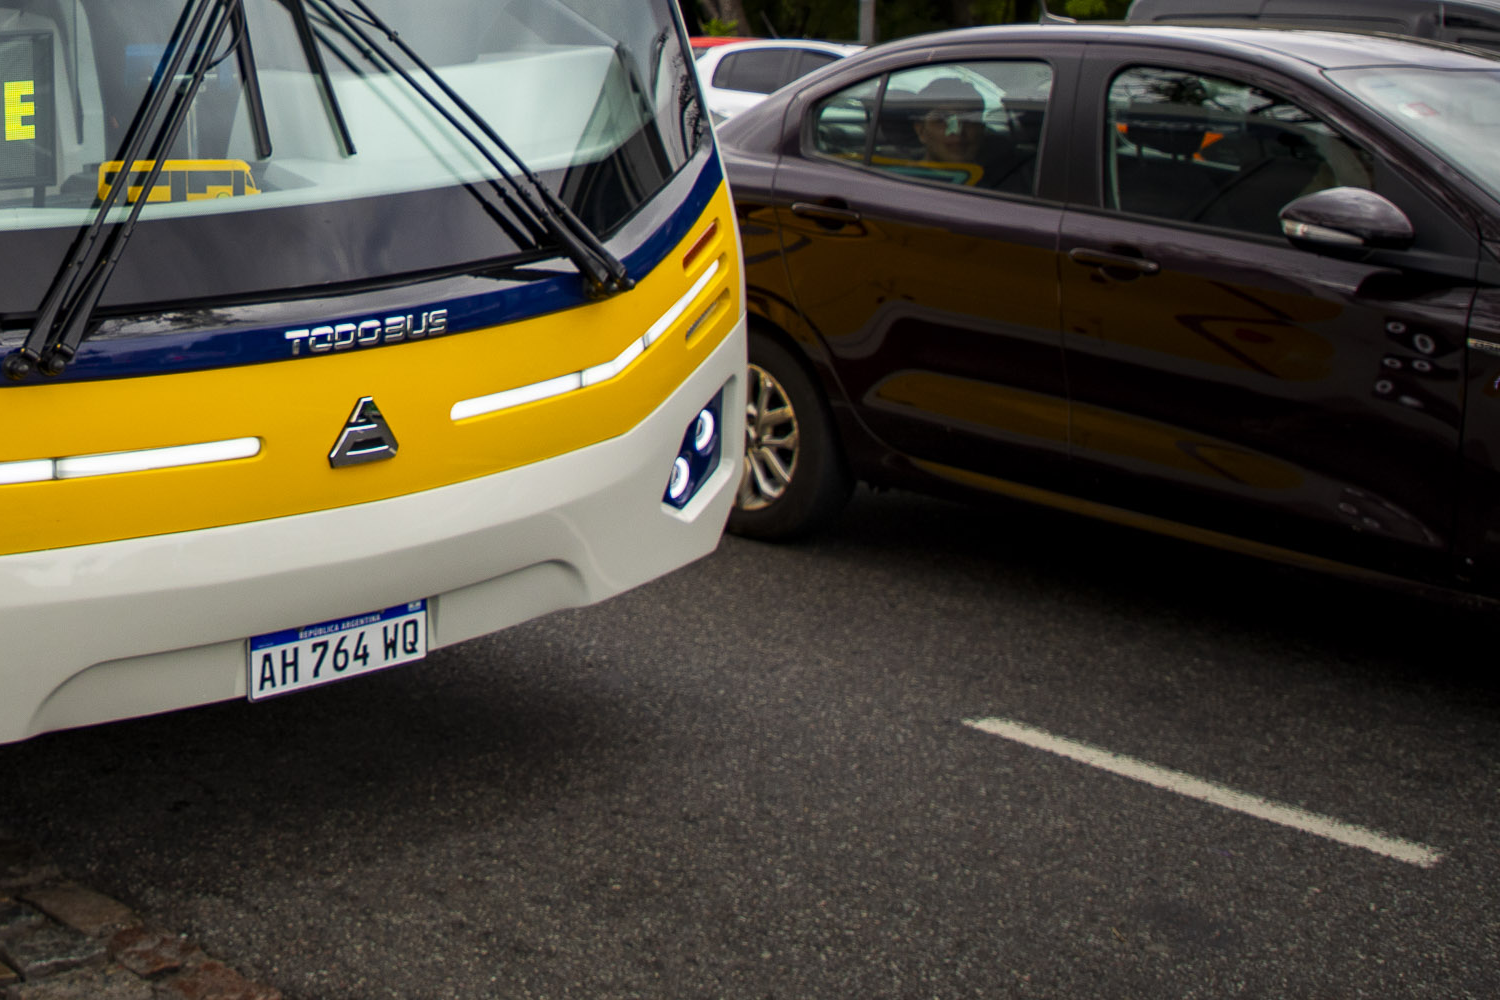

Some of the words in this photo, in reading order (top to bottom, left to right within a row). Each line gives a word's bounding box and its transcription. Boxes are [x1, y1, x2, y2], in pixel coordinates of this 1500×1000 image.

[284, 308, 448, 356] TODOBUS
[298, 622, 340, 640] REPÚBLICA
[340, 613, 382, 631] ARGENTINA
[258, 646, 299, 692] AH
[311, 630, 370, 679] 764
[382, 618, 419, 662] WQ
